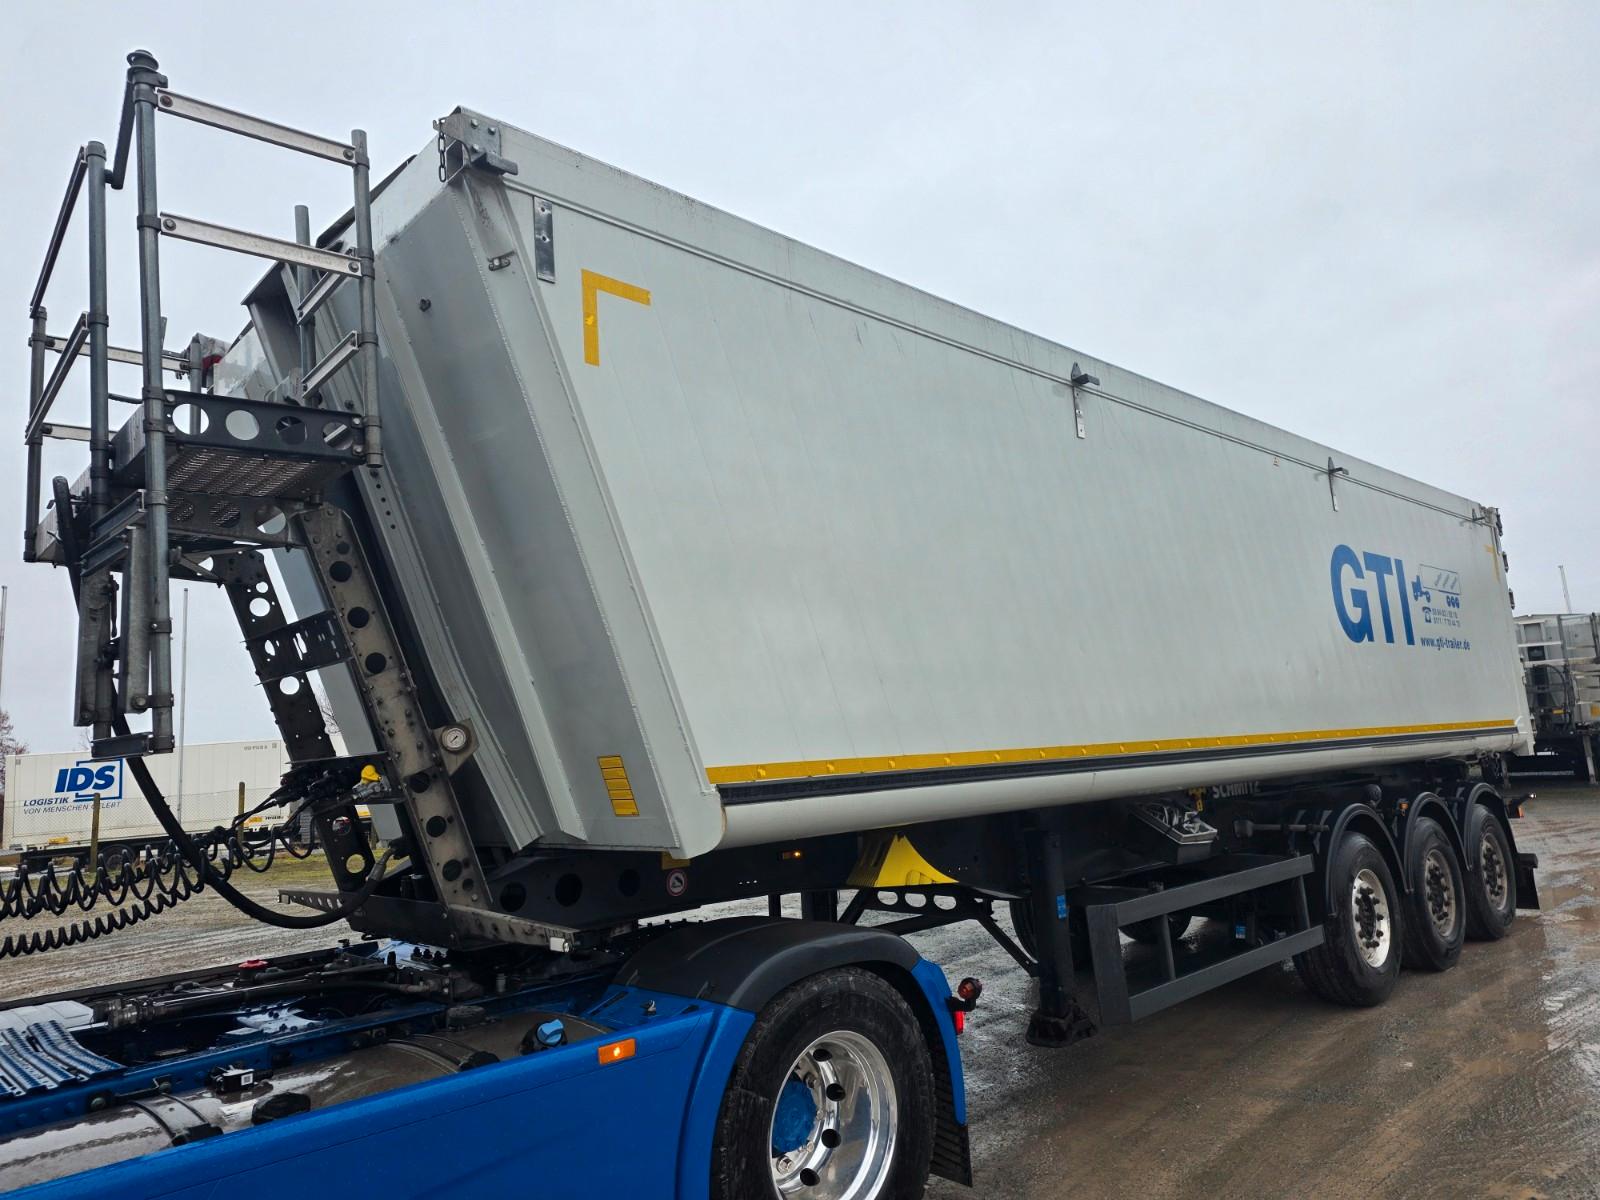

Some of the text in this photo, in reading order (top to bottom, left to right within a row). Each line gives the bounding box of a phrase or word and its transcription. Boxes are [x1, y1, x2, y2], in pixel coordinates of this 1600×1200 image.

[1331, 544, 1415, 646] GTI
[1421, 637, 1470, 650] www.gti-trailer.de
[55, 765, 116, 793] IDS
[23, 797, 69, 807] LOGISTIK
[42, 804, 89, 813] MENSCHEN
[91, 801, 121, 810] GLEBT
